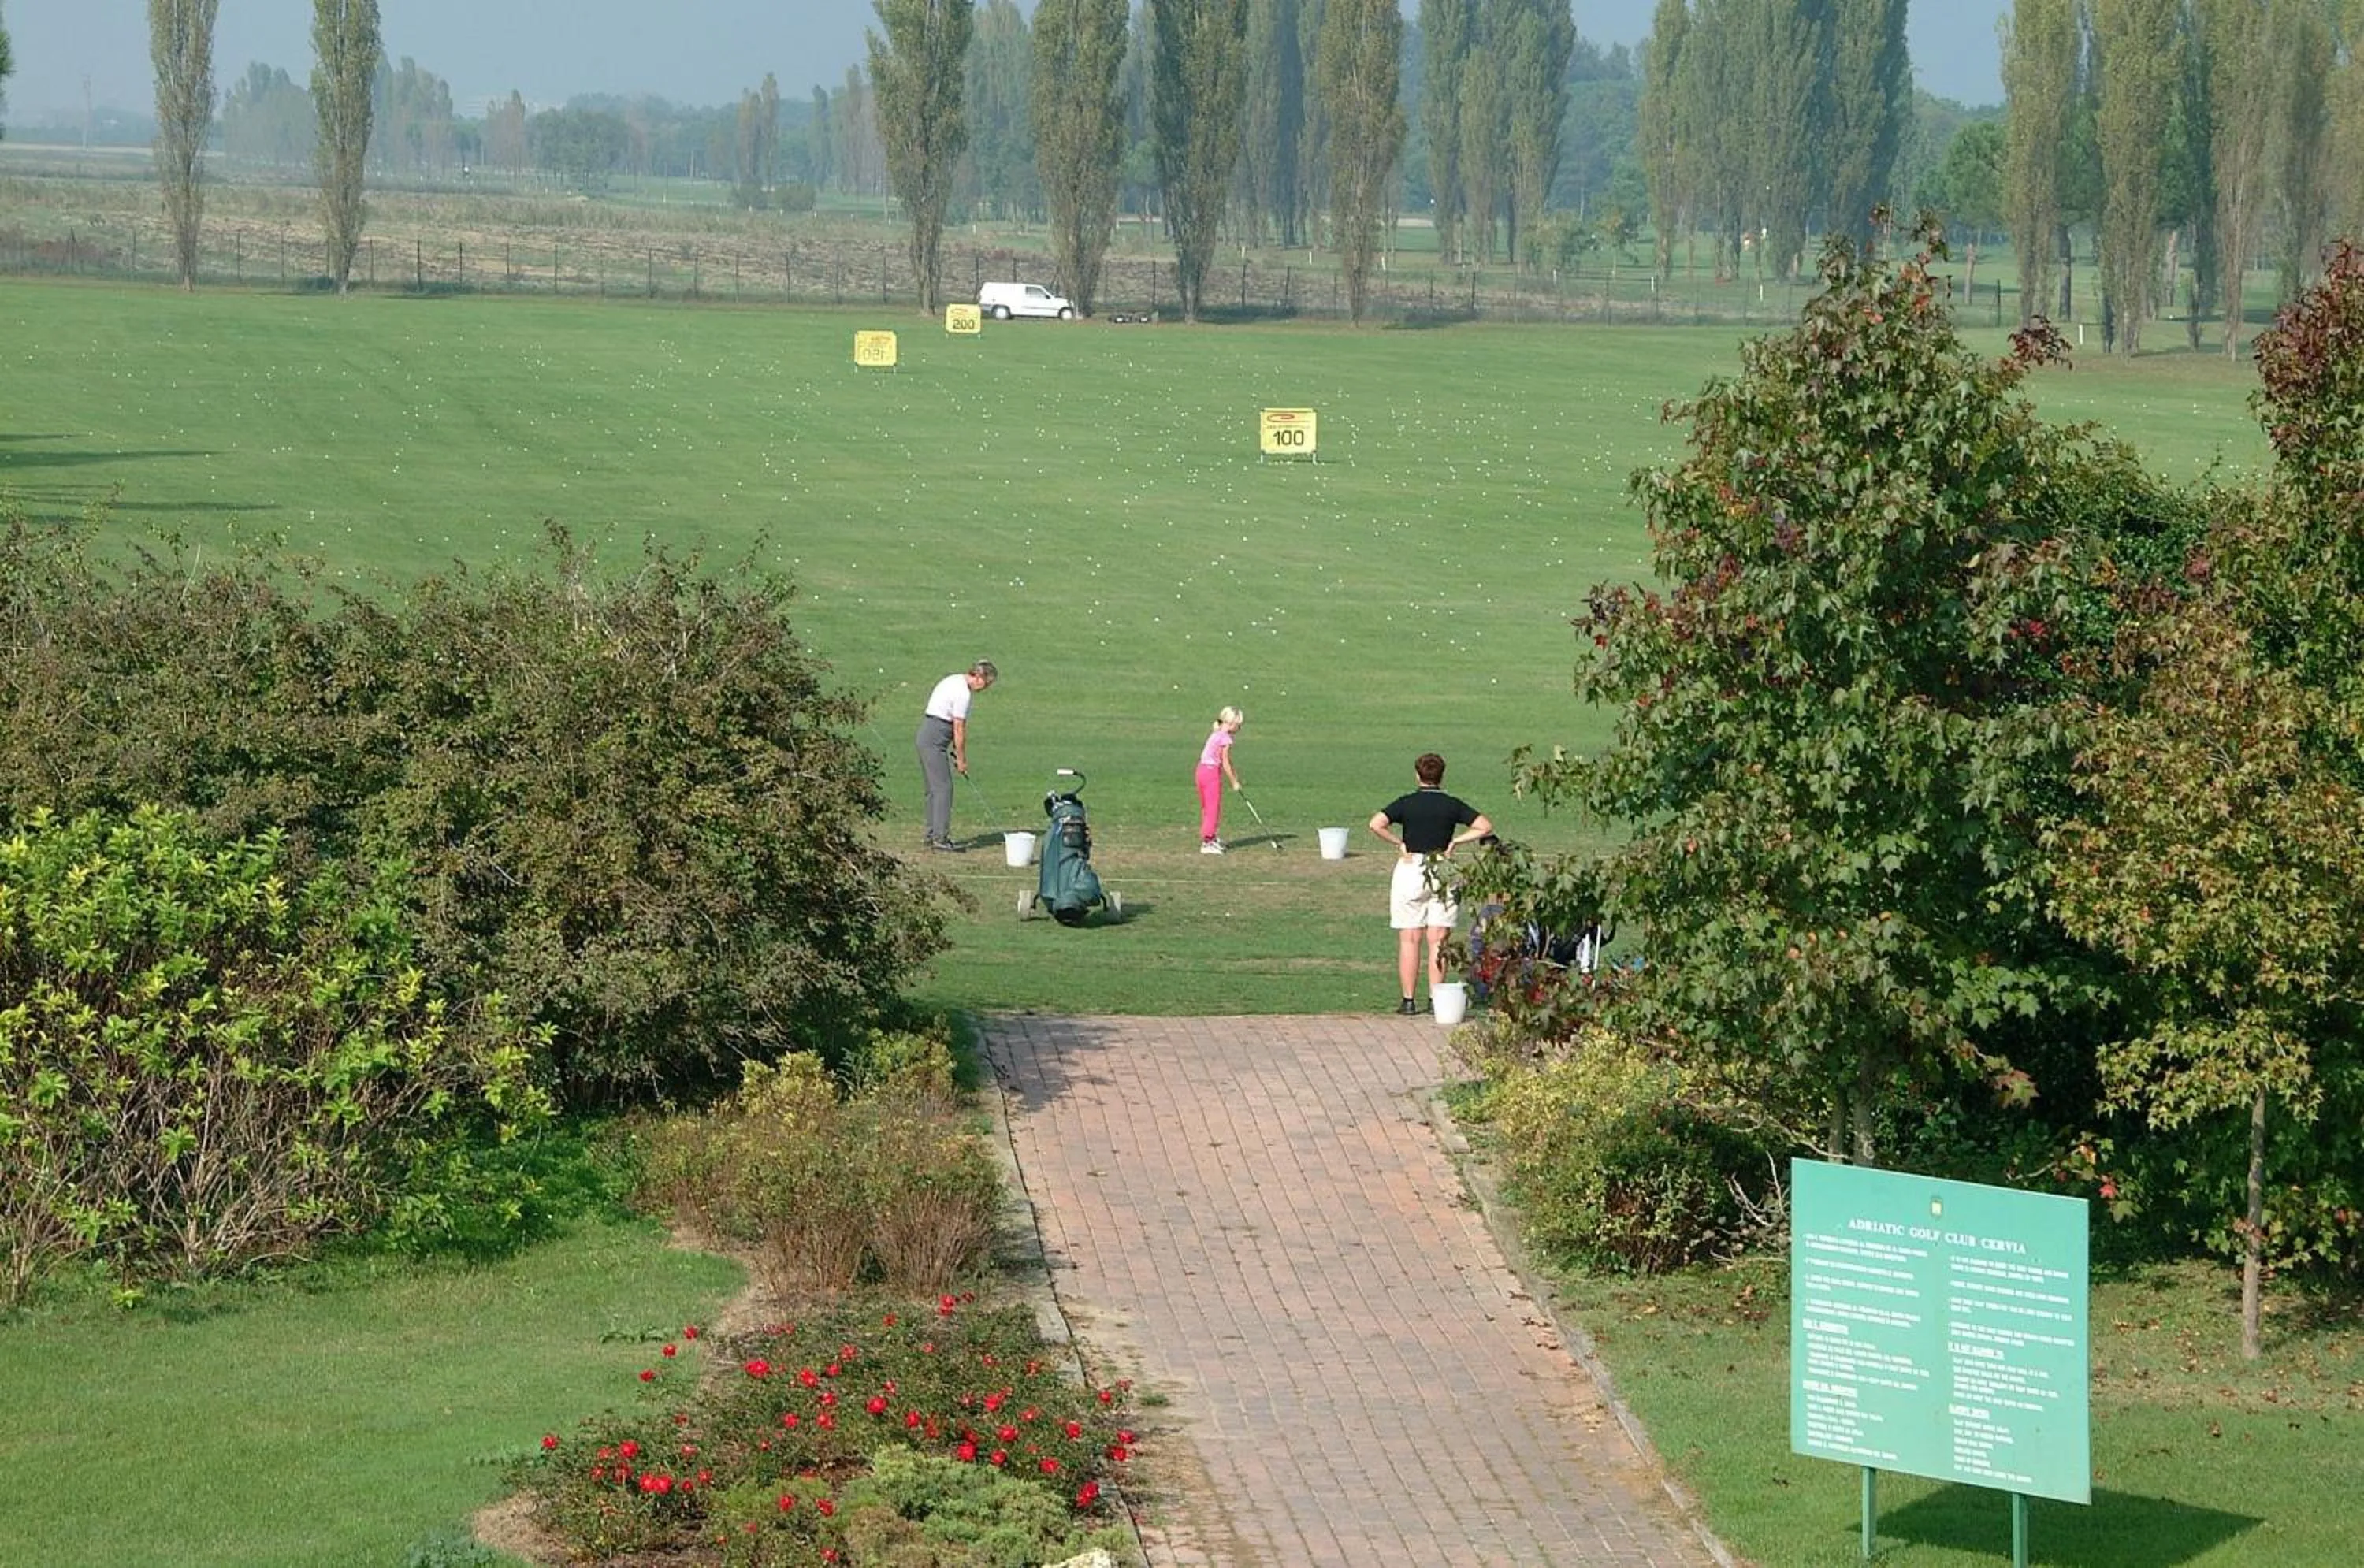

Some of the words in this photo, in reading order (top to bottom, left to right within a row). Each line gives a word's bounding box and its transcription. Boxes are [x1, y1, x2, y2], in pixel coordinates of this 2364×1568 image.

[952, 319, 975, 329] 200
[1273, 429, 1304, 446] 100
[1848, 1218, 1905, 1236] ADRIATIC
[1909, 1226, 1941, 1241] GOLF
[1944, 1232, 1976, 1247] CLUB
[1981, 1238, 2027, 1255] CERVIA
